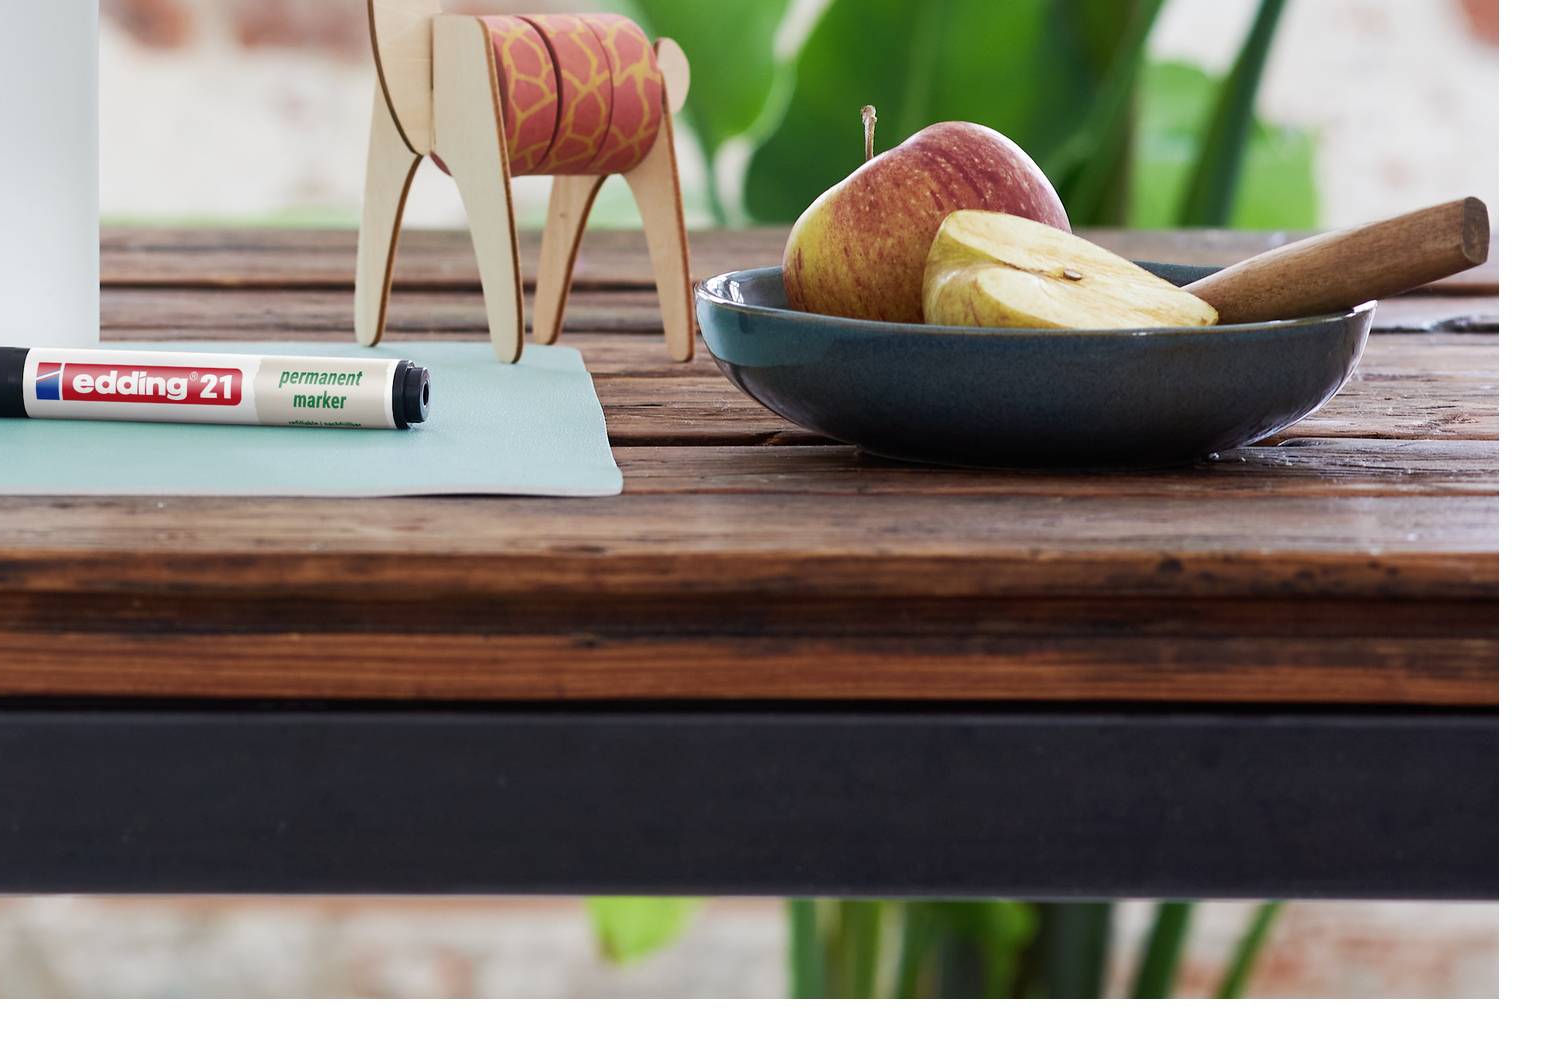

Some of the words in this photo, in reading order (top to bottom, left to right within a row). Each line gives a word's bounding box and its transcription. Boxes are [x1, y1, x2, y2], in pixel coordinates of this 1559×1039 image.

[200, 373, 233, 400] 21
[279, 371, 363, 388] permanent
[293, 391, 347, 409] marker
